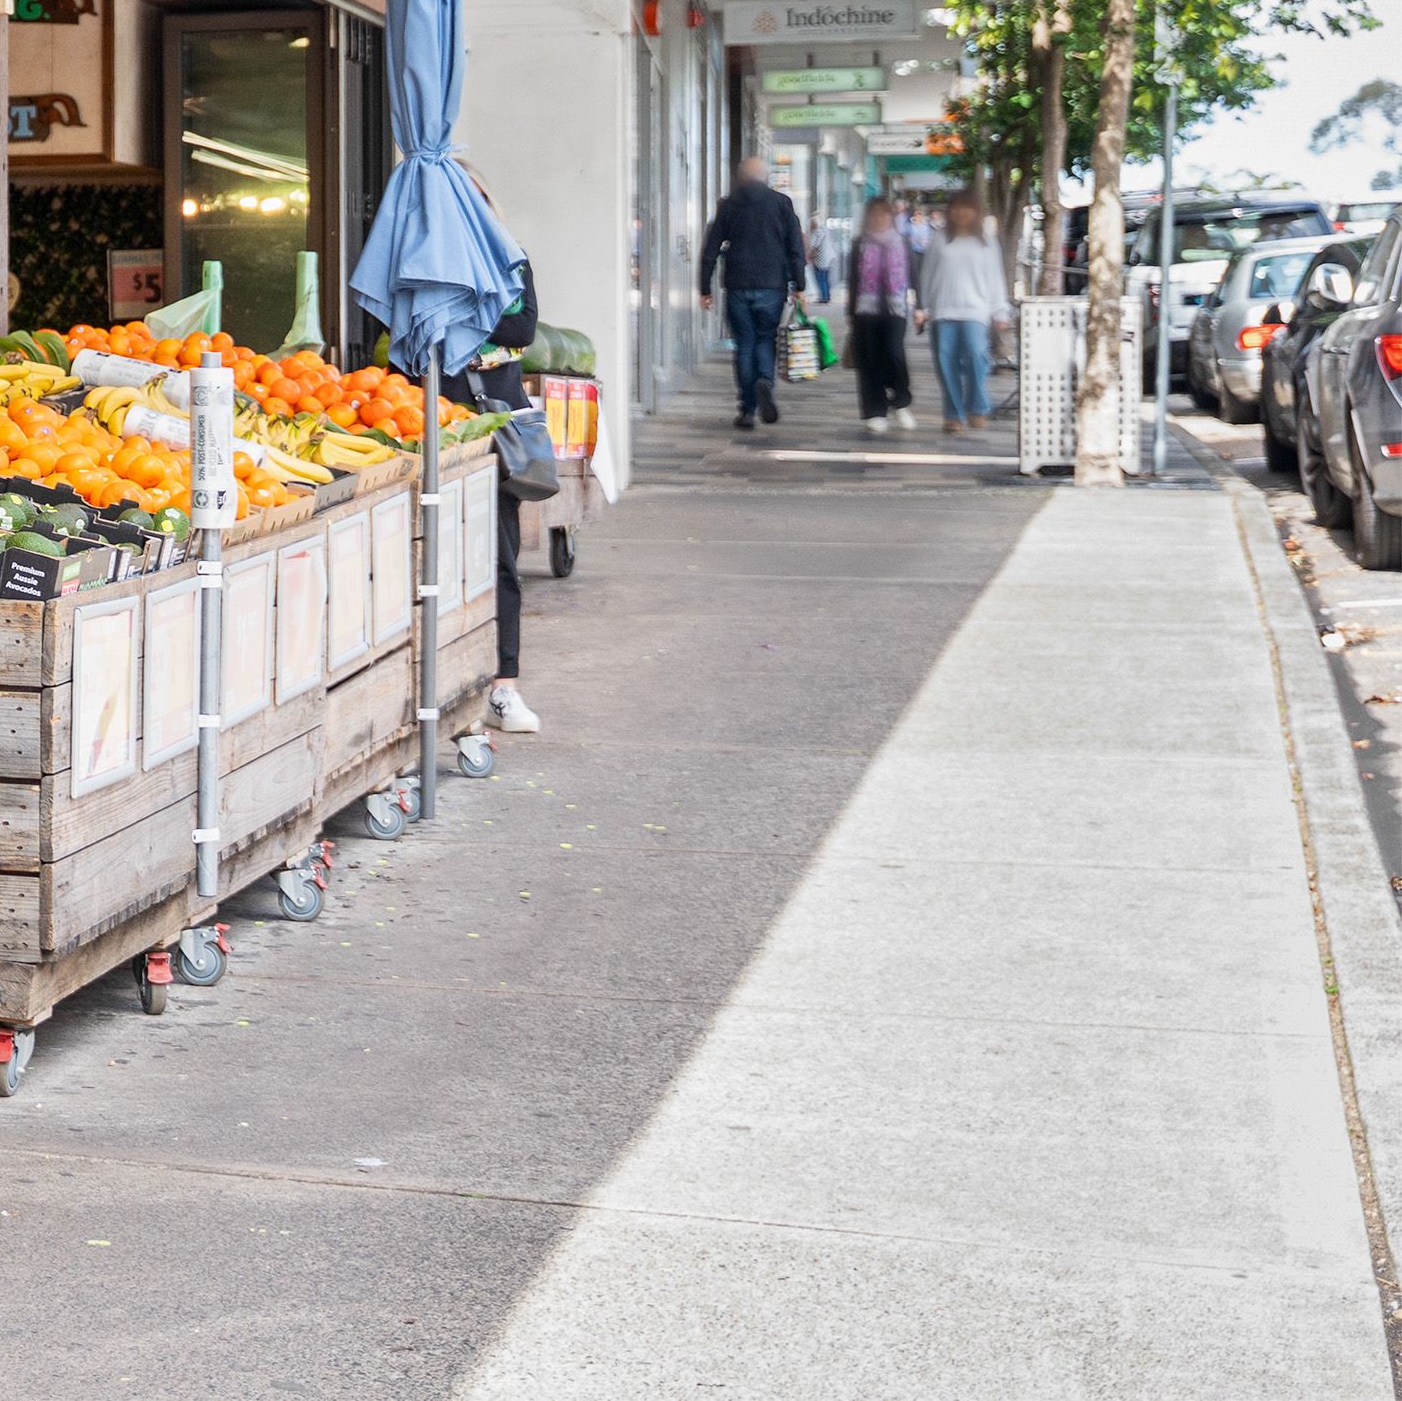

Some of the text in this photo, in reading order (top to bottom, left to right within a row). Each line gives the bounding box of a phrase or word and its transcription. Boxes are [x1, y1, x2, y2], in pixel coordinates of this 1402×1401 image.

[198, 415, 206, 465] POST-CONSUMER
[11, 562, 45, 577] Premium
[13, 573, 38, 586] Aussie
[6, 581, 41, 597] Avocados
